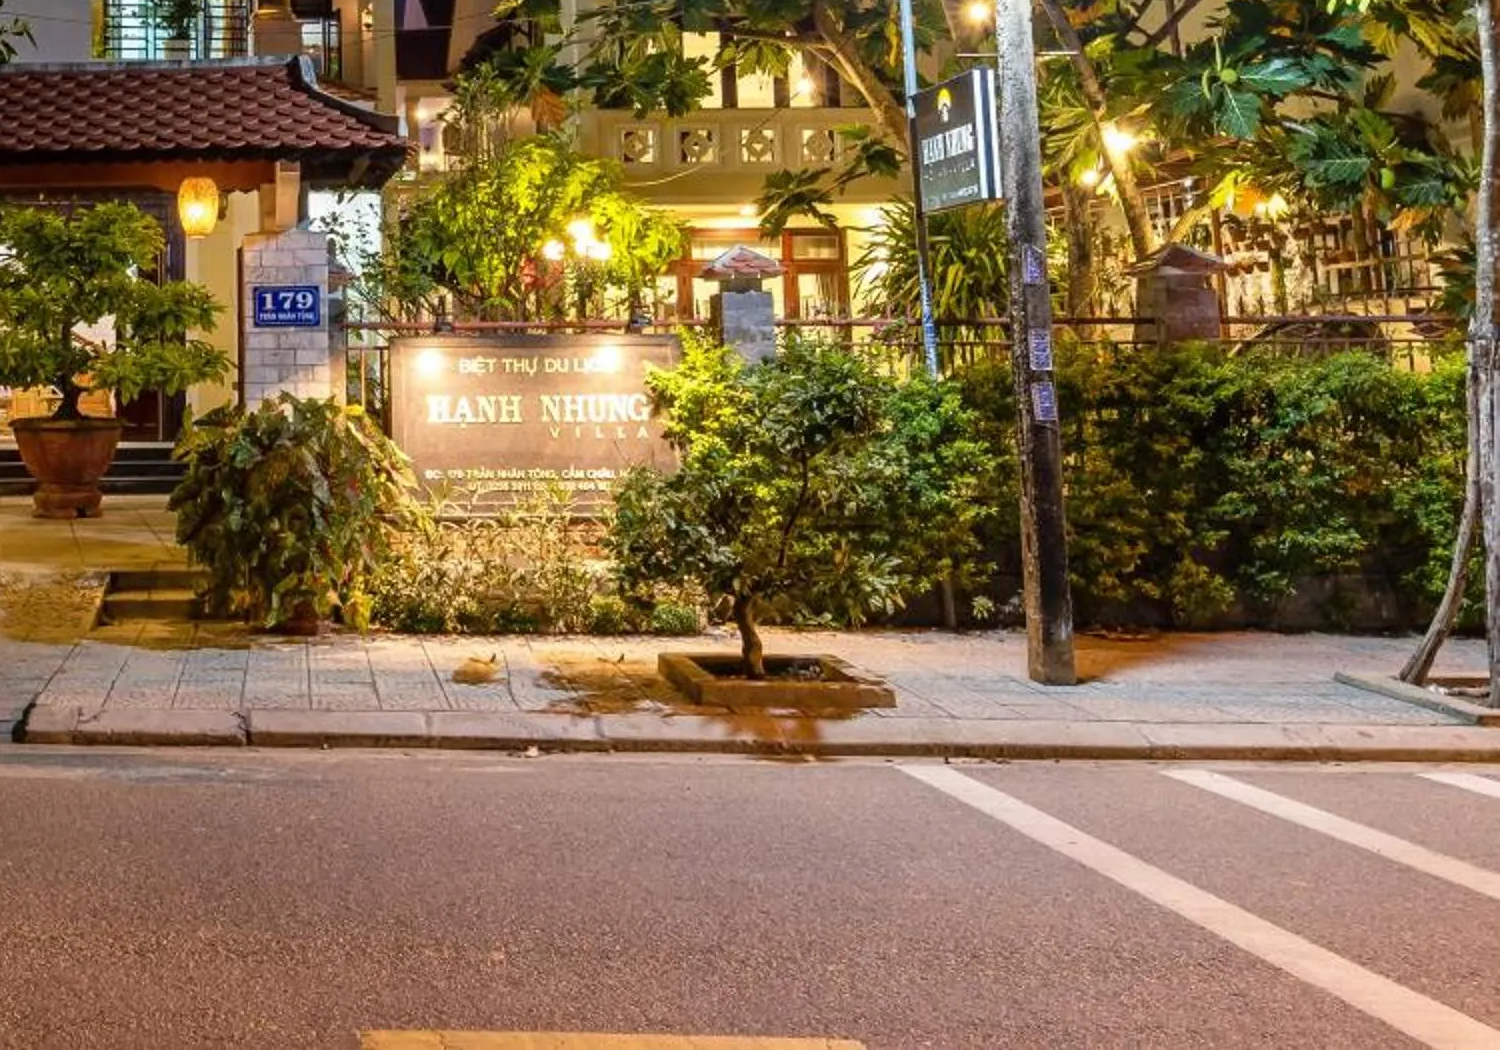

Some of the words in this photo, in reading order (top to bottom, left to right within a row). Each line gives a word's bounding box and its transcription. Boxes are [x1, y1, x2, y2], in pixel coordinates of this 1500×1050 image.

[261, 292, 314, 310] 179
[459, 355, 497, 376] BIỆT
[502, 357, 538, 377] THỤ
[544, 357, 569, 374] DU
[426, 395, 523, 428] HẠNH
[540, 393, 652, 423] NHUNG
